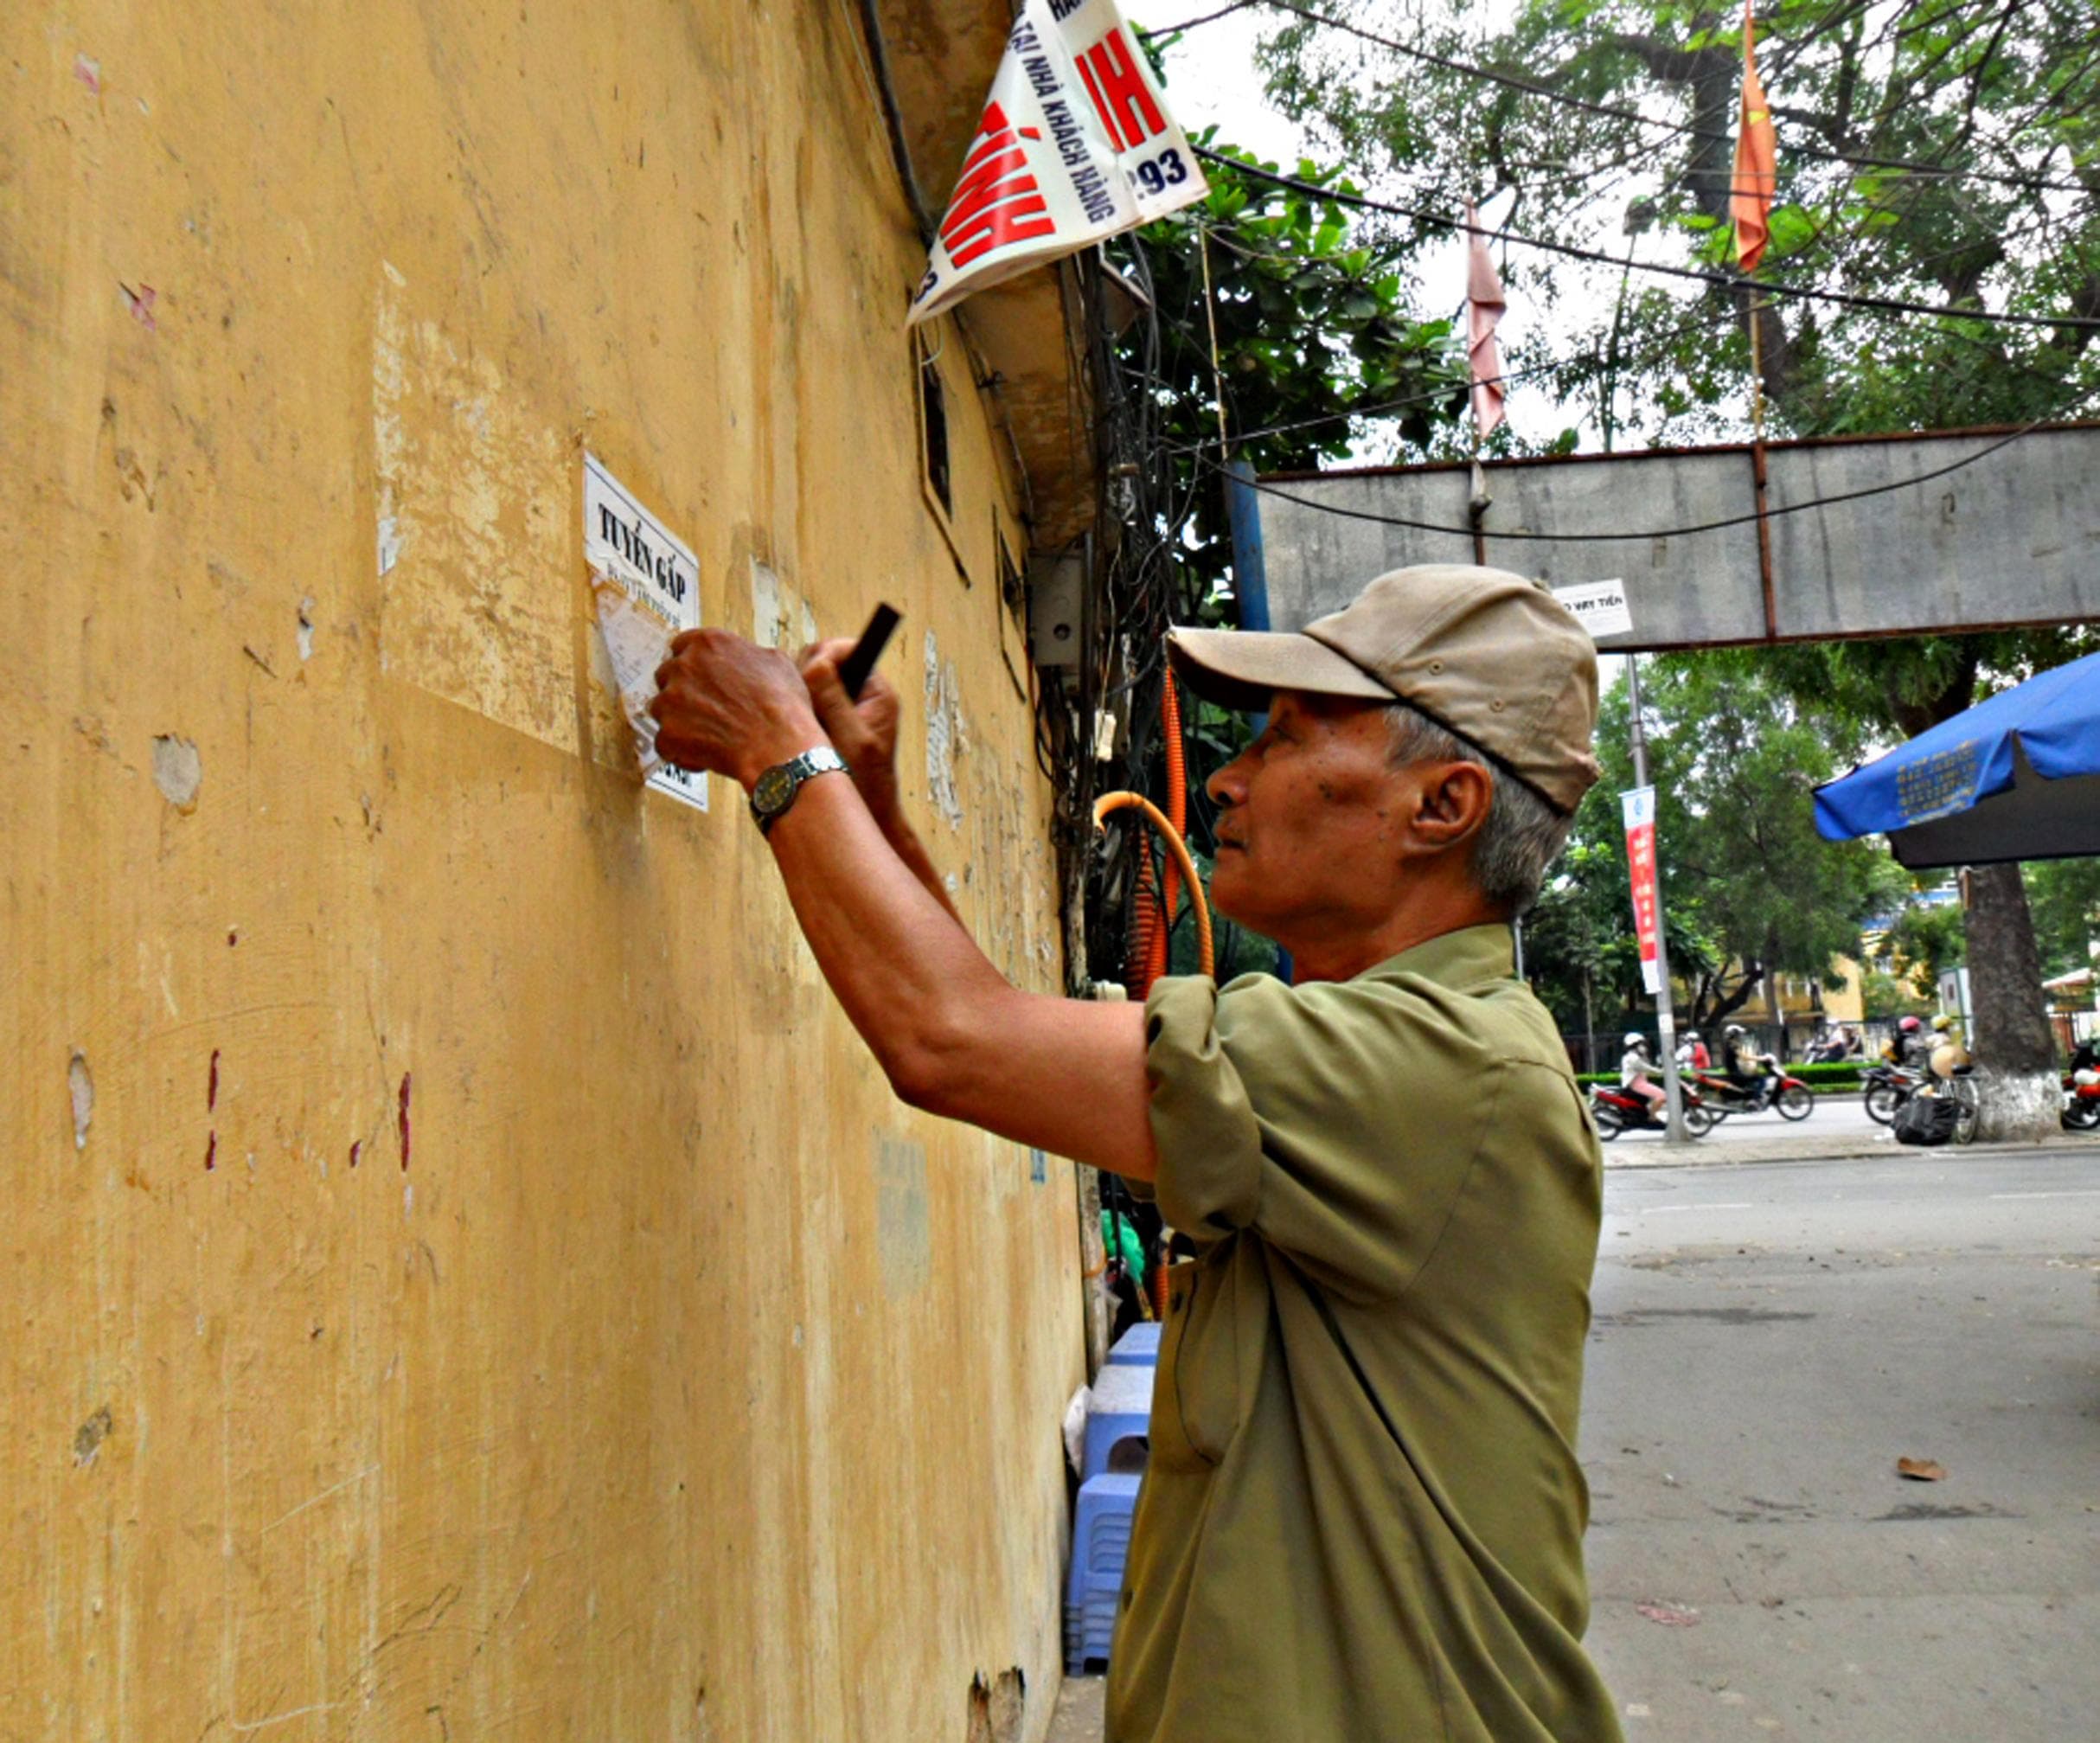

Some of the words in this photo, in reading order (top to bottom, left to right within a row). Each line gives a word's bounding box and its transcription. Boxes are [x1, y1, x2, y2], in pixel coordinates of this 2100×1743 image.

[1022, 55, 1065, 98] NHÀ
[1041, 99, 1091, 166] KHÁCH
[1069, 165, 1116, 224] HÀNG
